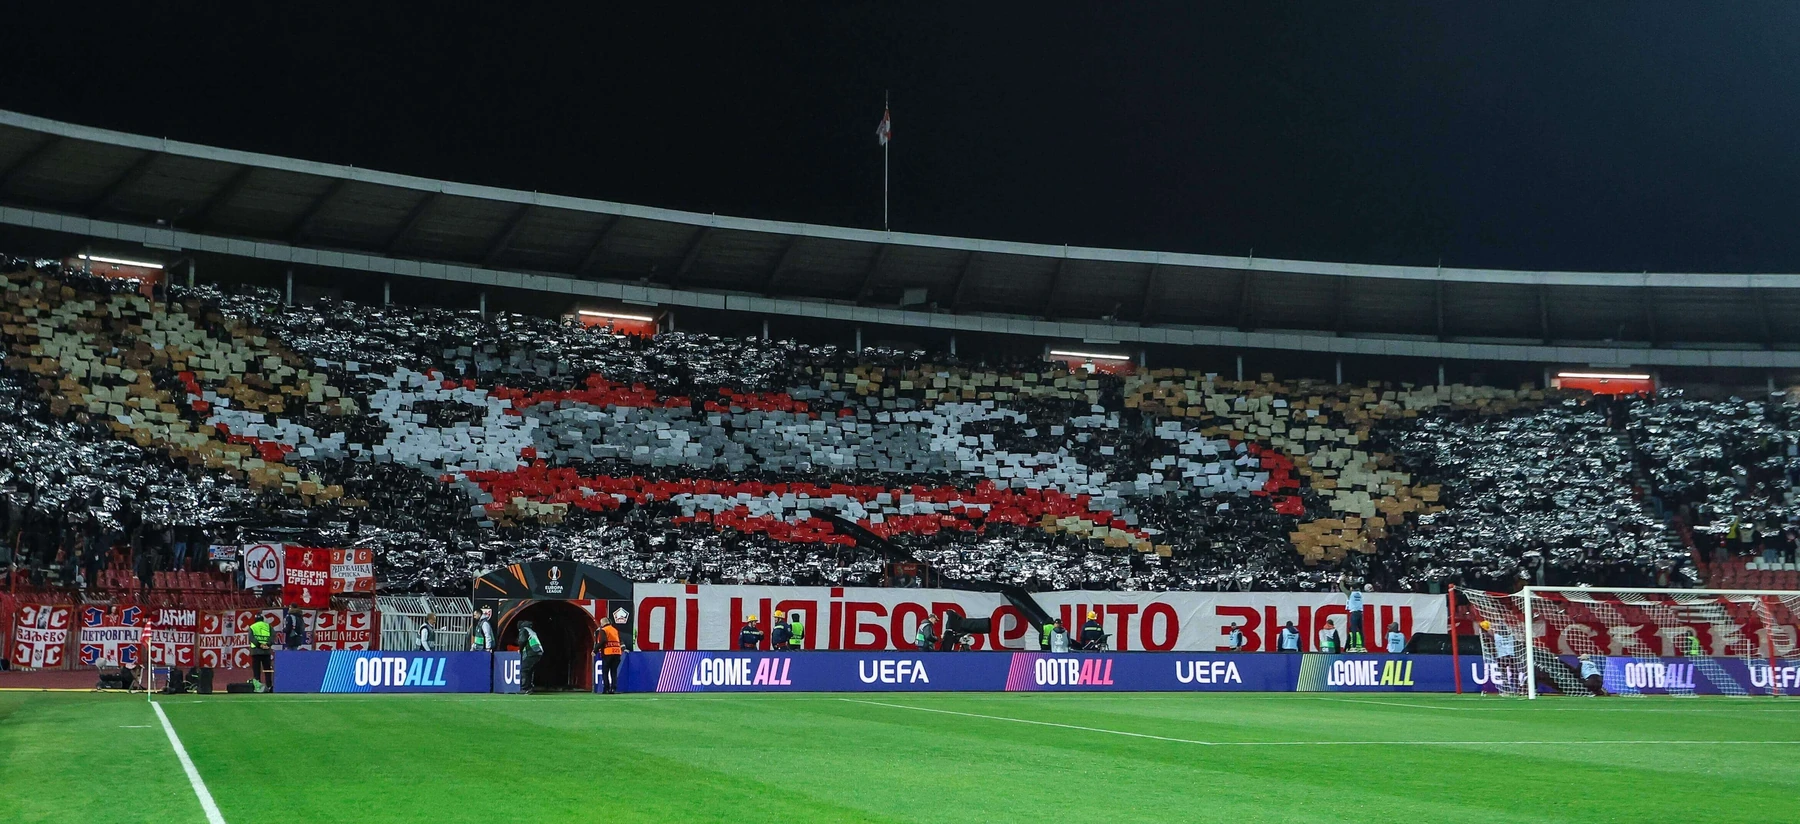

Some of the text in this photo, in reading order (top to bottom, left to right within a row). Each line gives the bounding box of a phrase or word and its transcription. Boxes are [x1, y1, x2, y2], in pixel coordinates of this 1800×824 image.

[247, 559, 276, 570] FAN ID
[286, 568, 328, 579] СЕВЕРНА
[287, 576, 325, 586] СРБИЈА
[17, 628, 66, 642] ВАЉЕВО
[82, 629, 139, 642] ПЕТРОВГРАД
[317, 631, 364, 641] НИШЛИЈЕ
[354, 657, 447, 686] OOTBALL
[753, 657, 792, 686] ALL
[859, 659, 930, 684] UEFA
[1035, 658, 1114, 686] OOTBALL
[1175, 661, 1242, 684] UEFA
[1380, 660, 1414, 686] ALL
[1625, 662, 1697, 689] OOTBALL
[1749, 666, 1800, 688] UEF
